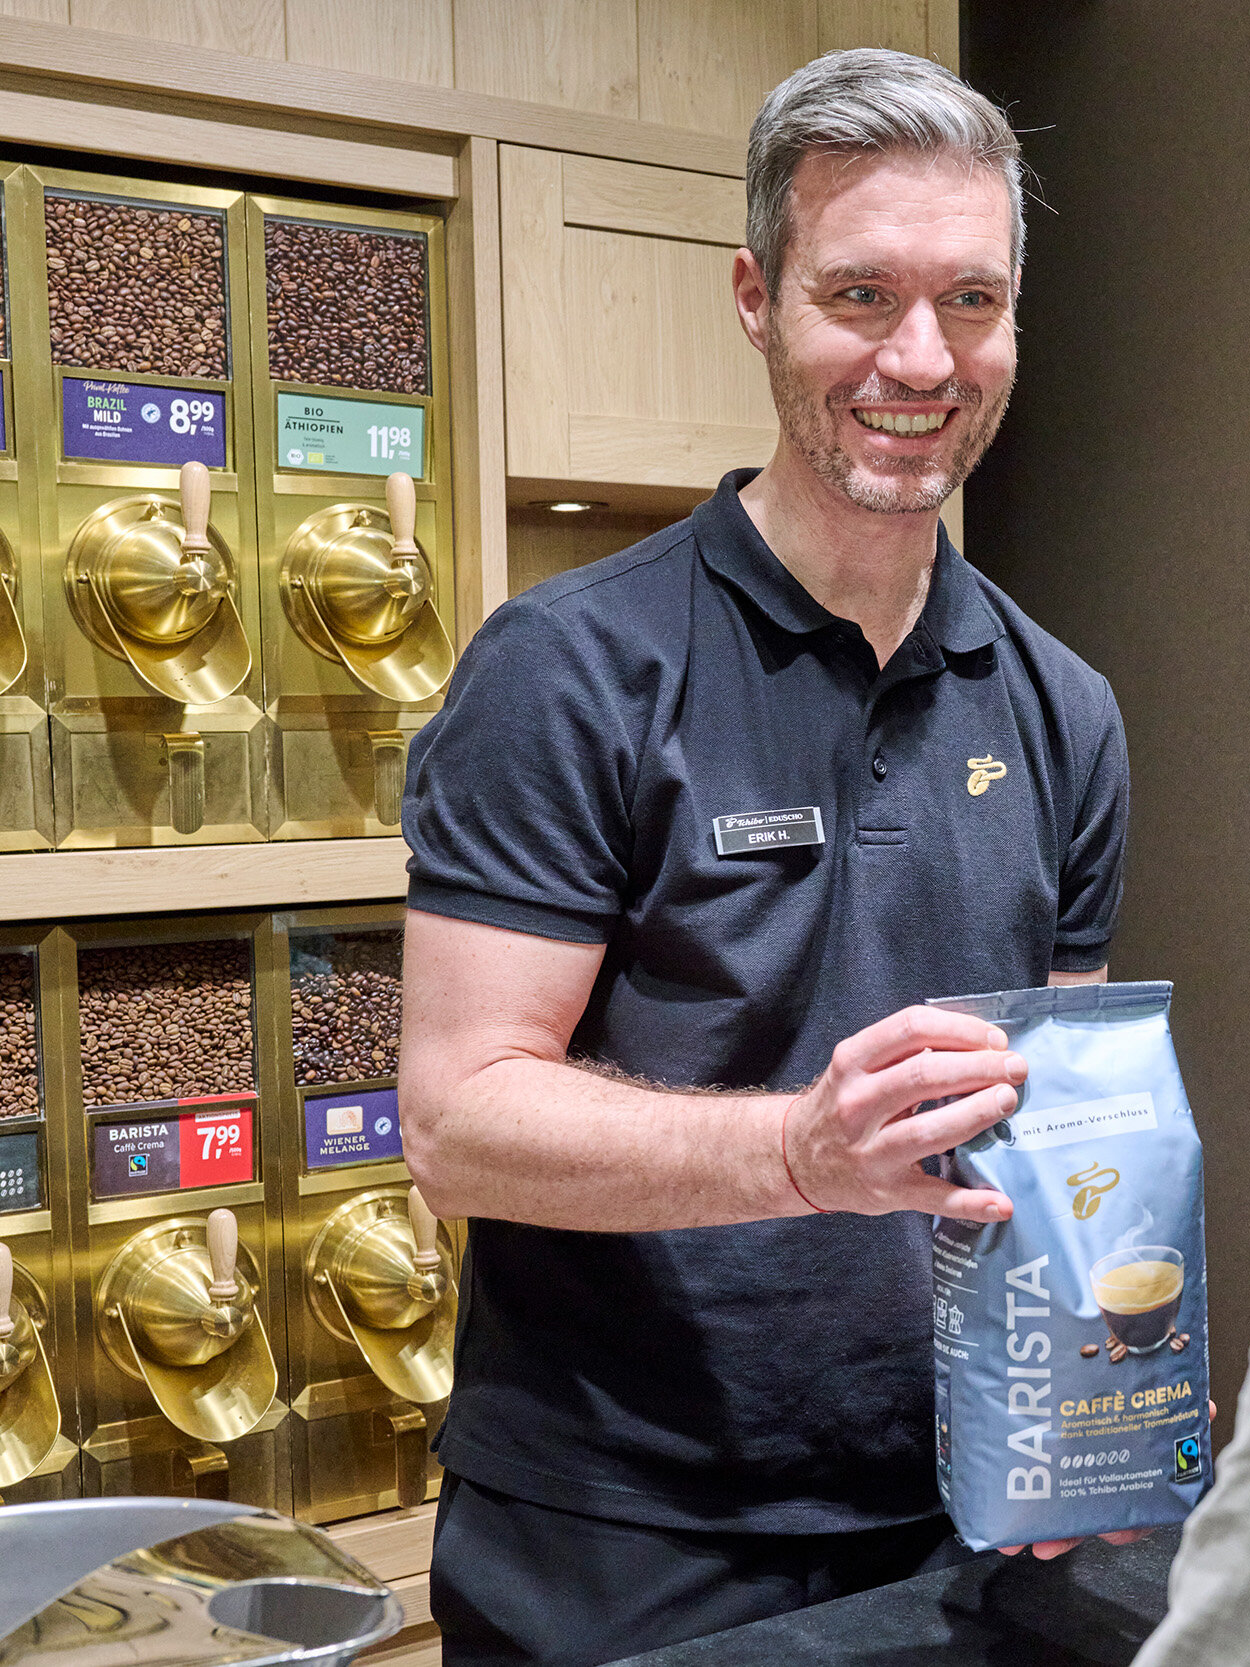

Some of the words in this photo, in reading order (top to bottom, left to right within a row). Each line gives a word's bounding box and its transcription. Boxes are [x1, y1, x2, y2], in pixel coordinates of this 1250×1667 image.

[88, 396, 127, 410] BRAZIL
[94, 410, 121, 423] MILD
[170, 399, 214, 436] 8,99
[304, 408, 324, 416] BIO
[285, 418, 344, 434] ÄTHIOPIEN
[367, 426, 412, 460] 11,98
[736, 816, 764, 827] Tchibo
[768, 814, 803, 822] EDUSCHO
[748, 831, 776, 844] ERIK
[778, 830, 790, 840] H.
[1023, 1128, 1041, 1136] mit
[1046, 1108, 1148, 1132] Aroma-Verschluss
[110, 1124, 168, 1142] BARISTA
[197, 1124, 240, 1159] 7,99
[324, 1136, 366, 1146] WIENER
[114, 1143, 136, 1153] Caffè
[138, 1140, 164, 1150] Crema
[320, 1142, 370, 1155] MELANGE
[1006, 1254, 1051, 1500] BARISTA
[1060, 1390, 1125, 1416] CAFFÈ
[1131, 1380, 1192, 1408] CREMA
[1061, 1417, 1112, 1428] Aromatisch
[1122, 1406, 1169, 1421] harmonisch
[1086, 1424, 1141, 1437] traditioneller
[1144, 1408, 1198, 1429] Trommelröstung
[1060, 1478, 1082, 1486] Ideal
[1084, 1477, 1096, 1485] für
[1099, 1468, 1162, 1483] Vollautomaten
[1060, 1489, 1077, 1498] 100
[1090, 1484, 1118, 1494] Tchibo
[1119, 1481, 1154, 1491] Arabica
